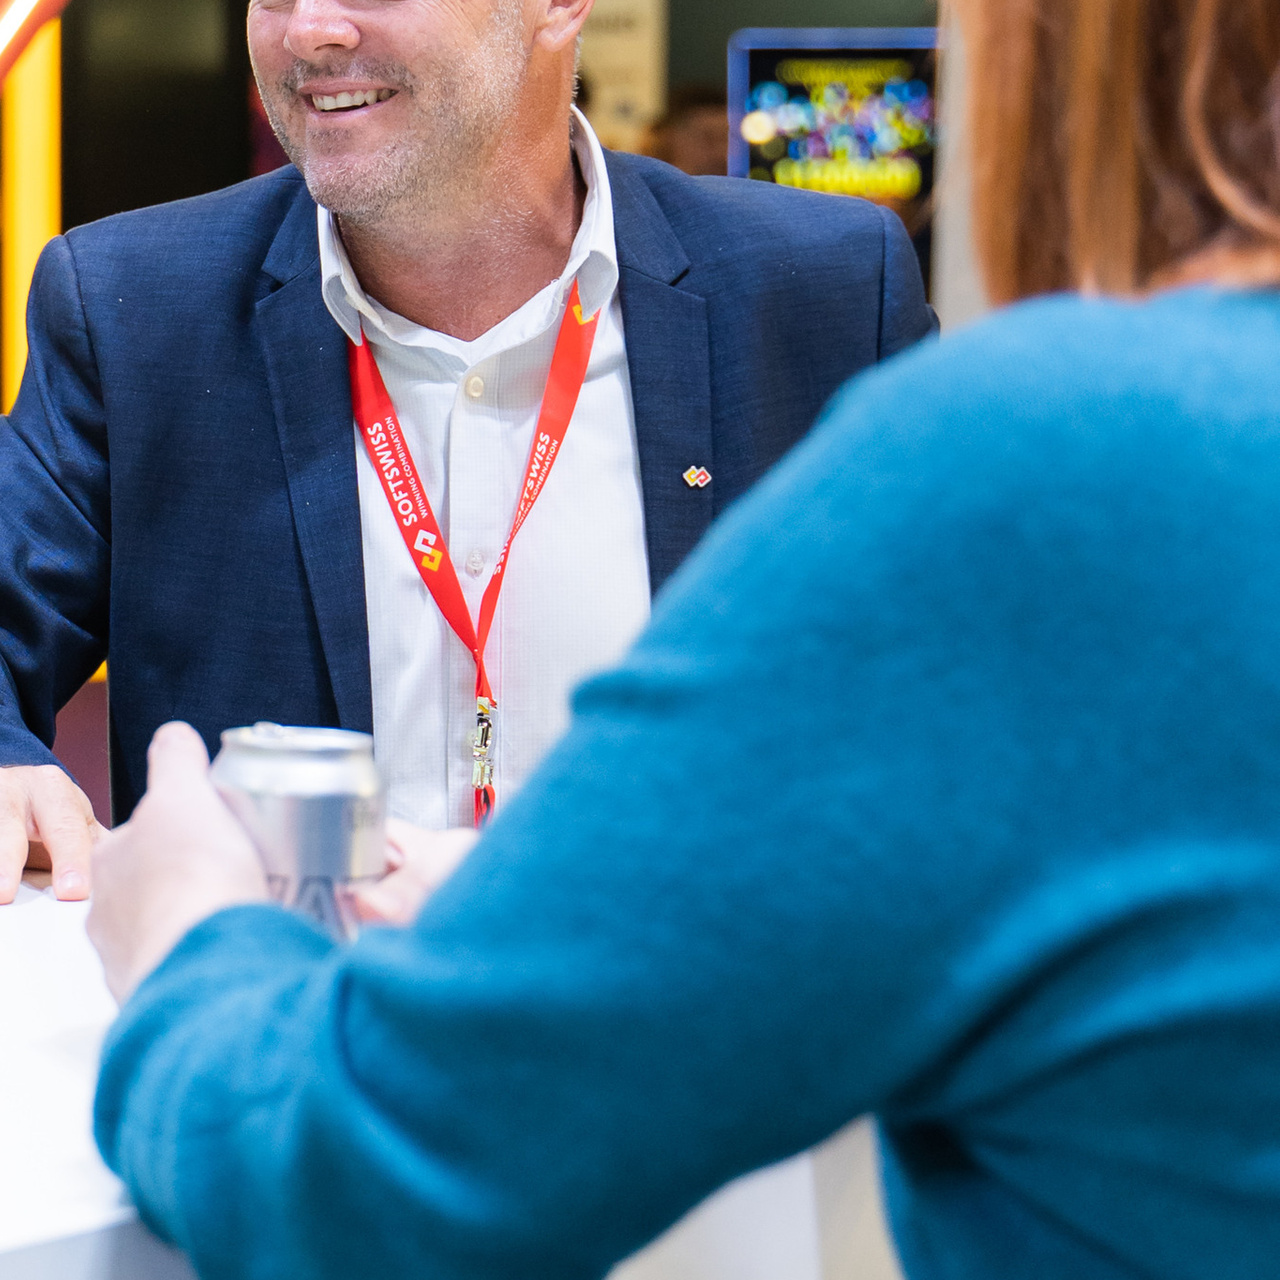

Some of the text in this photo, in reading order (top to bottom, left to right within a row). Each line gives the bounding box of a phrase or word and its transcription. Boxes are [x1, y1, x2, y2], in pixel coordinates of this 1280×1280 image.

[367, 422, 418, 526] SOFTSWISS
[384, 416, 428, 519] WINNING COMBINATION
[530, 439, 559, 501] COMBINATION
